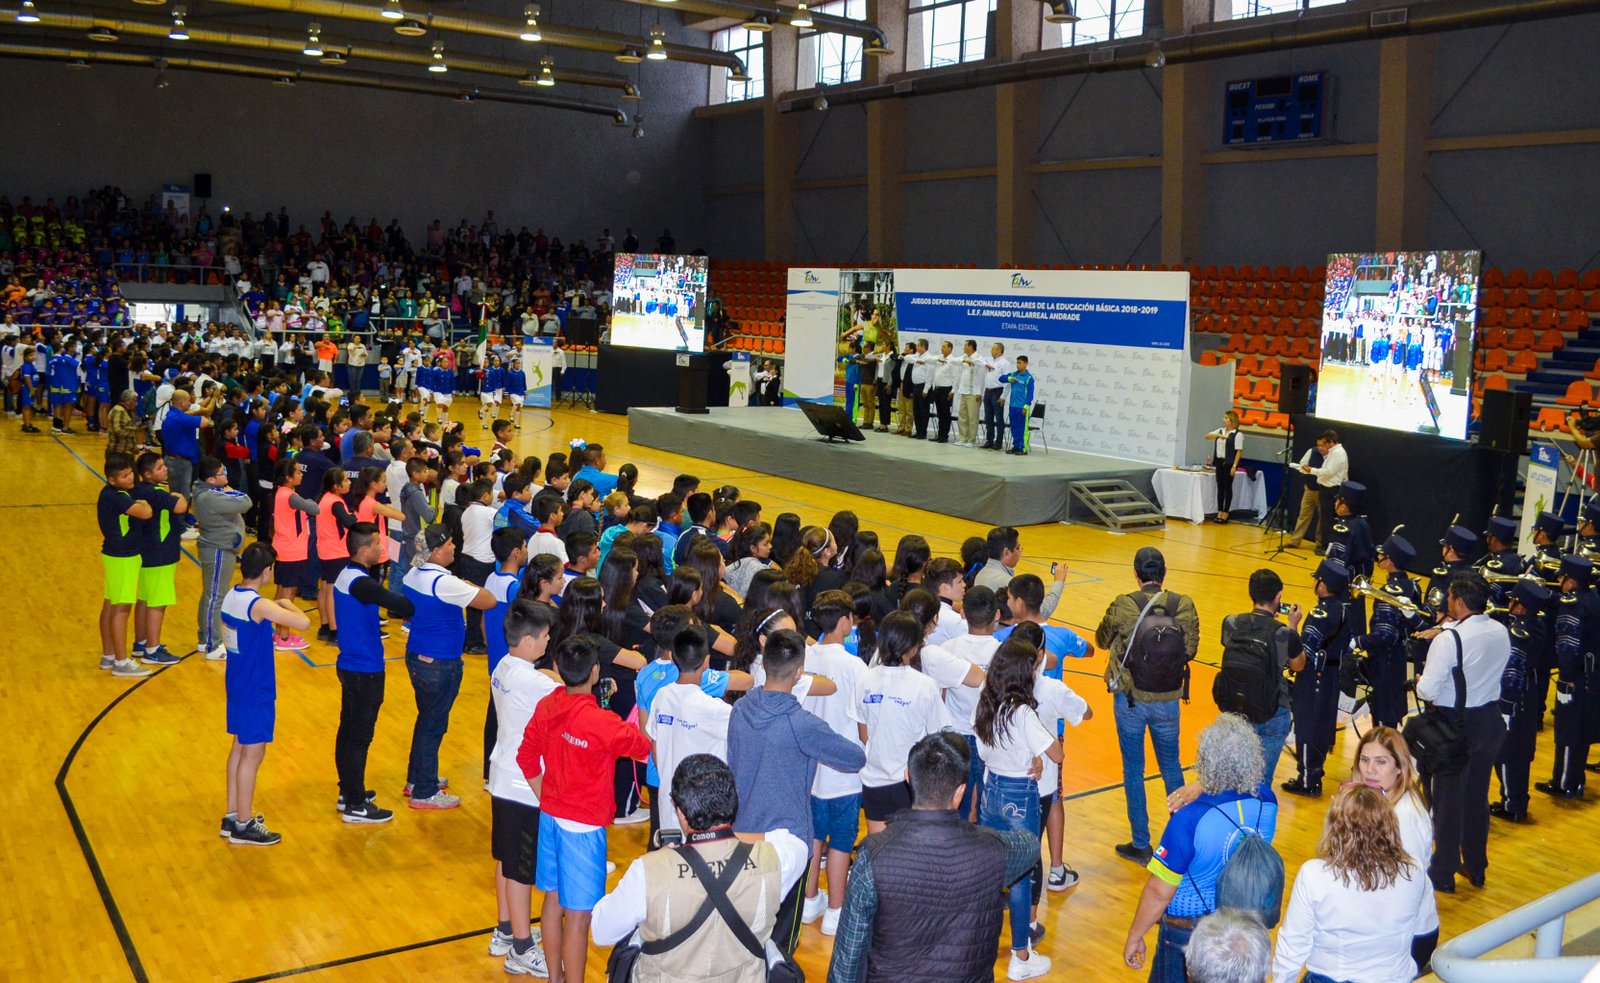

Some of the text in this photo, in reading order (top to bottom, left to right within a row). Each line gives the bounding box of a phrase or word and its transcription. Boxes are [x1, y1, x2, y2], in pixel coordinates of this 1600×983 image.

[1298, 74, 1319, 83] HOME
[1229, 82, 1250, 91] GUEST
[910, 297, 931, 305] JUEGOS
[932, 298, 965, 306] DEPORTIVOS
[966, 299, 1001, 308] NACIONALES
[1002, 300, 1036, 309] ESCOLARES
[1047, 302, 1055, 310] LA
[1056, 303, 1094, 312] EDUCACIÓN
[1096, 303, 1120, 313] BÁSICA
[1121, 305, 1159, 314] 2018-2019
[982, 309, 1011, 318] ARMANDO
[1012, 310, 1048, 319] VILLARREAL
[1049, 312, 1080, 321] ANDRADE
[1001, 322, 1039, 332] ETAPA ESTATAL
[691, 831, 716, 841] Canon
